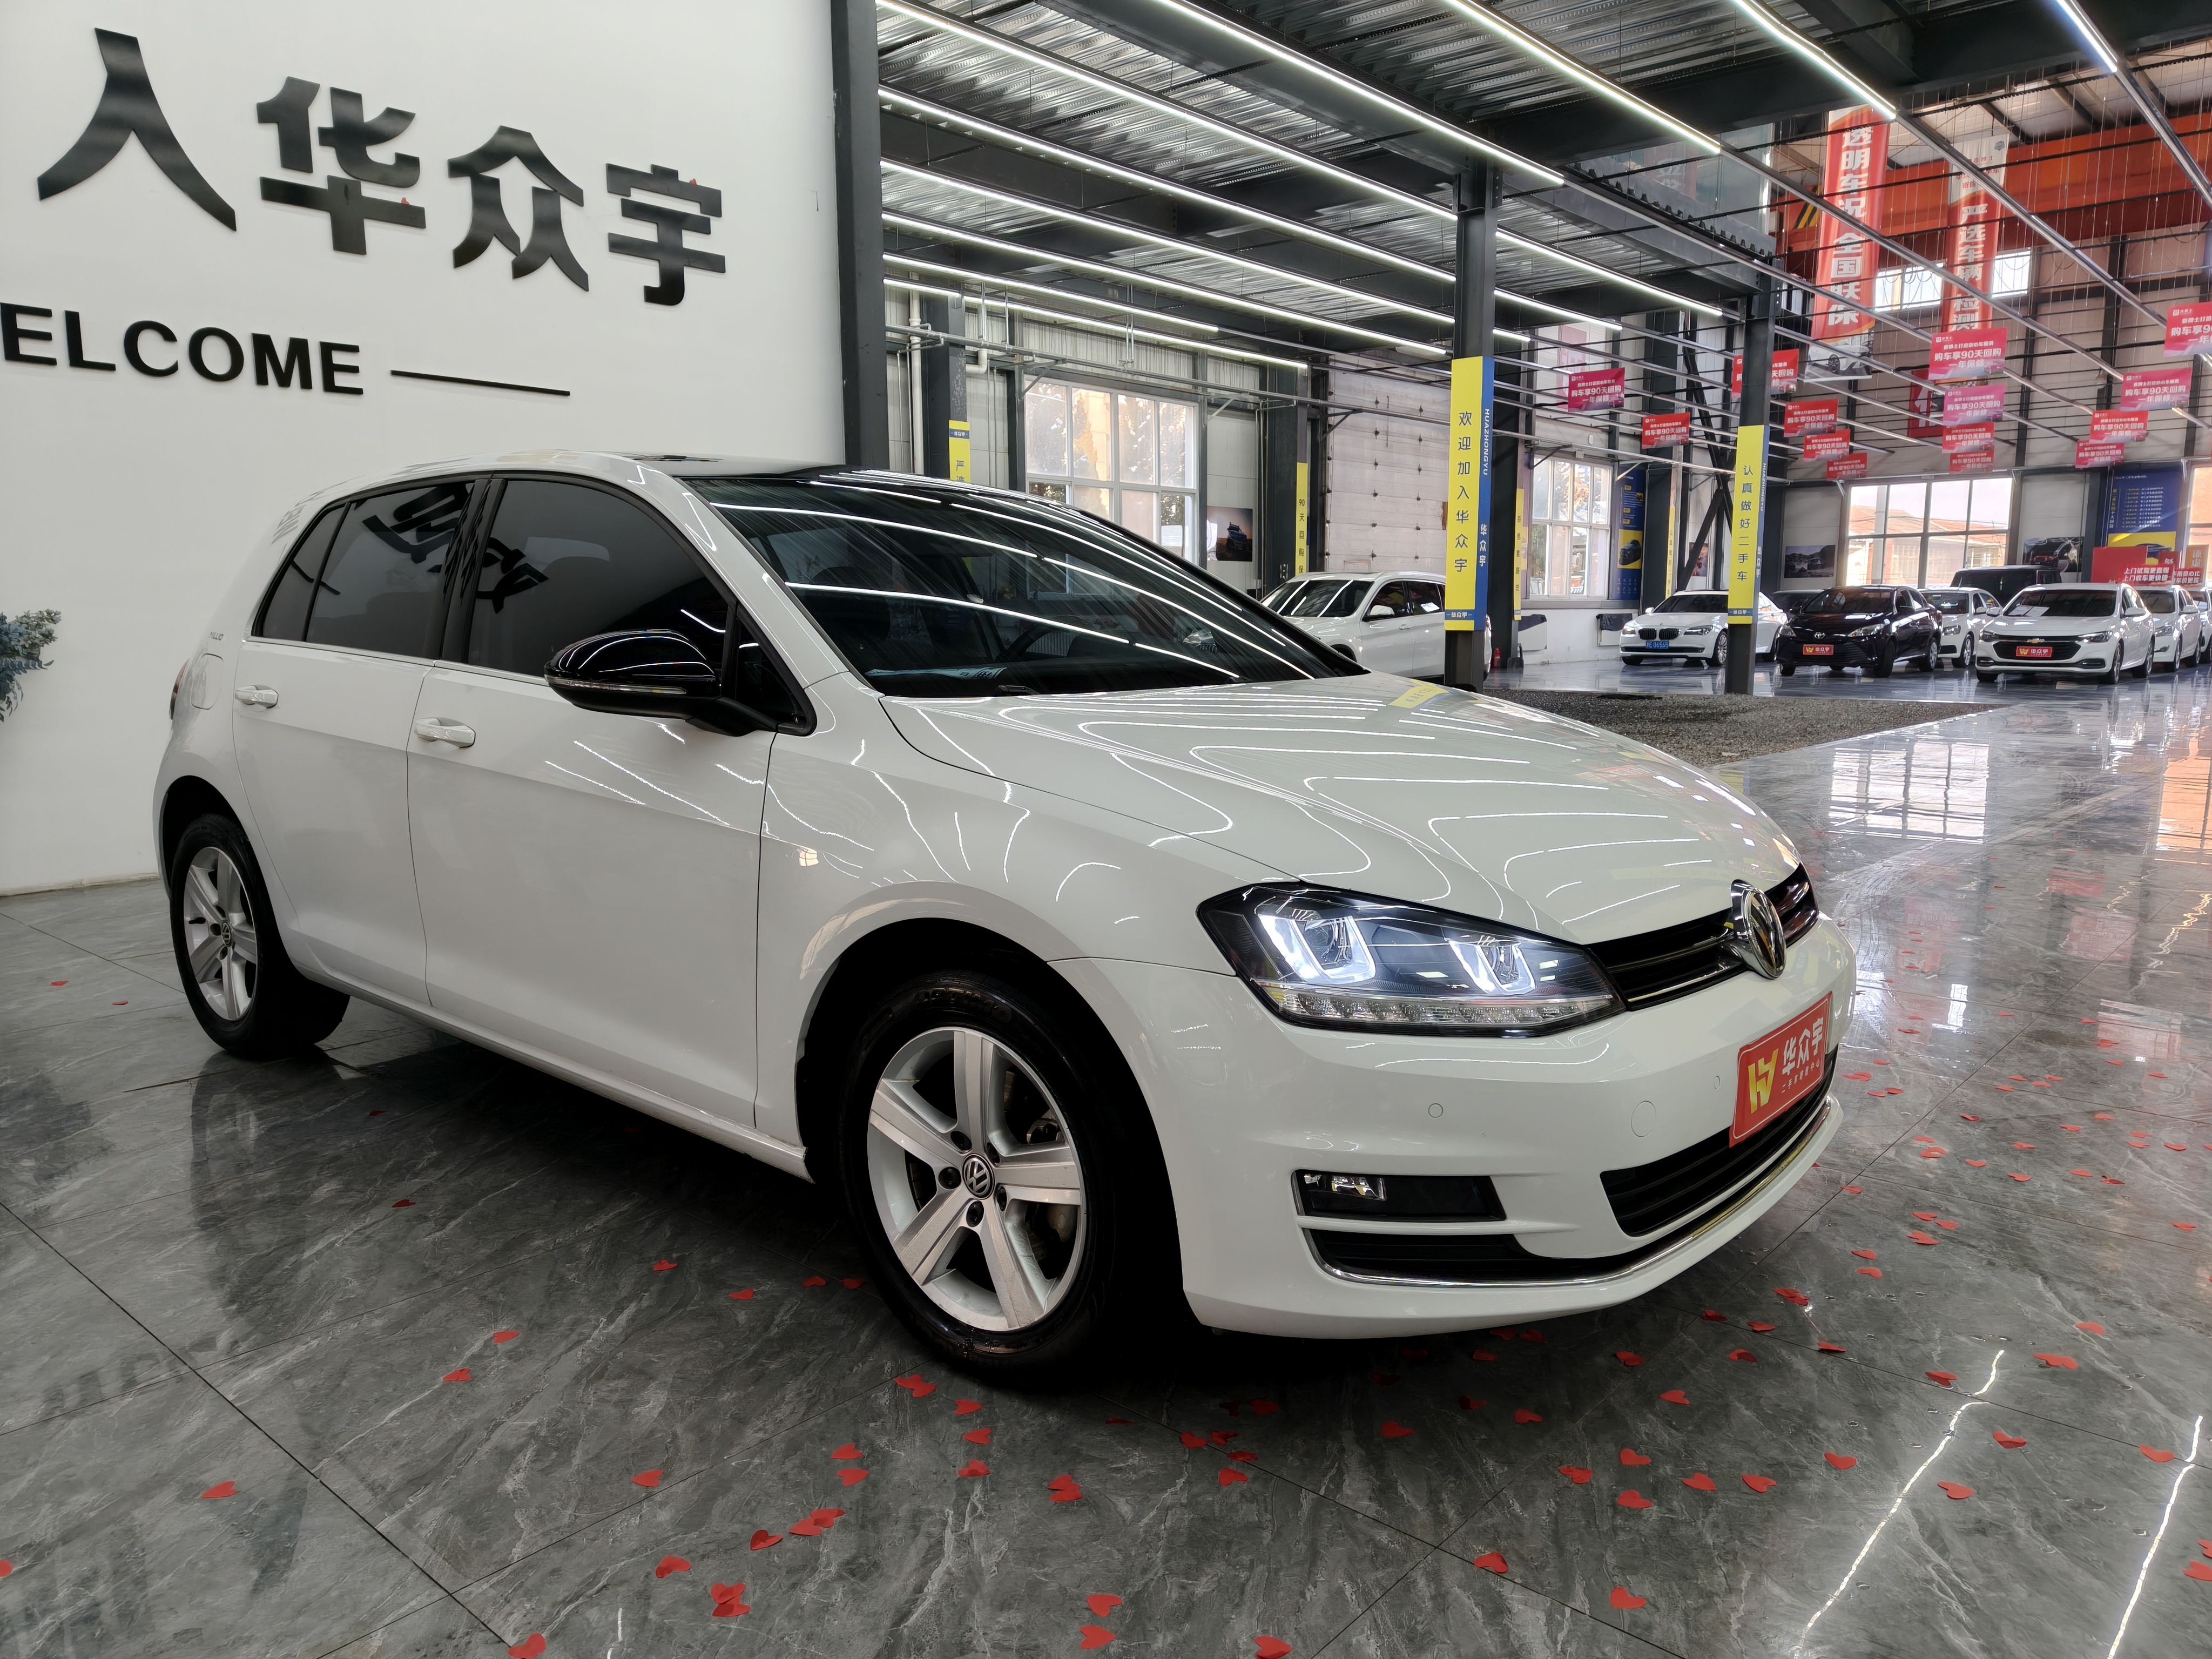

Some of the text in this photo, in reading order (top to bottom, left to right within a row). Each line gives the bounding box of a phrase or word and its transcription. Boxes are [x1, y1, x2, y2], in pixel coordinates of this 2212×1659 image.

[2171, 325, 2212, 336] 购车享9
[0, 302, 363, 395] ELCOME
[1934, 348, 2001, 361] 购车享90天回购
[1948, 359, 1985, 369] 一年保修
[1572, 385, 1622, 397] 购车享90天回购
[2125, 385, 2186, 396] 购车享90天回购
[1582, 395, 1610, 403] 一年保修
[1947, 400, 2001, 411] 购车享90天回购
[1788, 414, 1835, 424] 购车享90天回购
[1645, 427, 1687, 436] 购车享90天回购
[2094, 422, 2144, 430] 购车享90天回购
[1945, 433, 1991, 441] 购车享90天回购
[1454, 411, 1472, 572] 欢迎加入华众宇
[1736, 464, 1754, 582] 认真做好二手车
[1479, 523, 1488, 567] 华众宇
[1782, 1016, 1824, 1076] 华众宇
